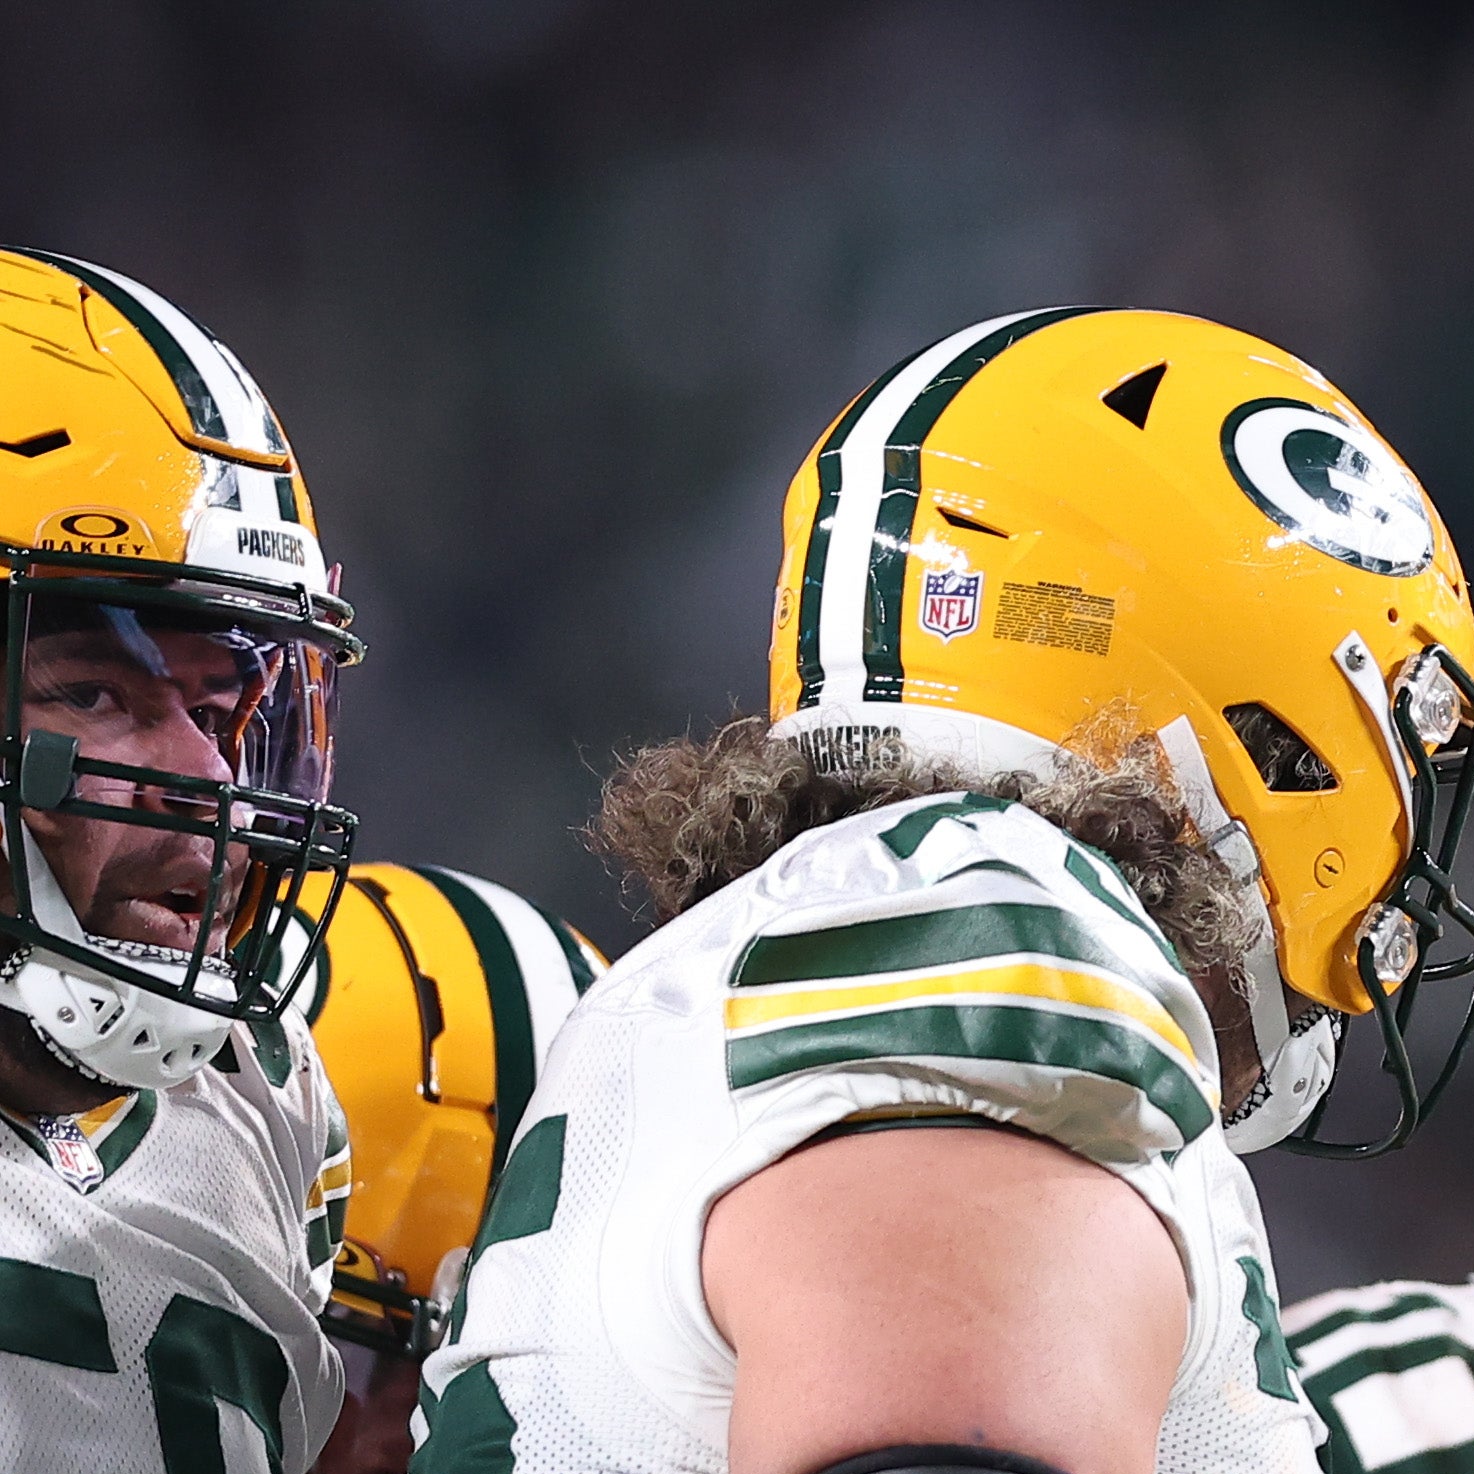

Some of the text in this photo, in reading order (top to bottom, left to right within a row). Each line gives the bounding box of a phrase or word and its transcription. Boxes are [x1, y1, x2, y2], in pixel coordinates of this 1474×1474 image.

[41, 538, 146, 556] OAKLEY
[237, 527, 305, 567] PACKERS
[928, 597, 971, 630] NFL
[51, 1140, 95, 1175] NFL
